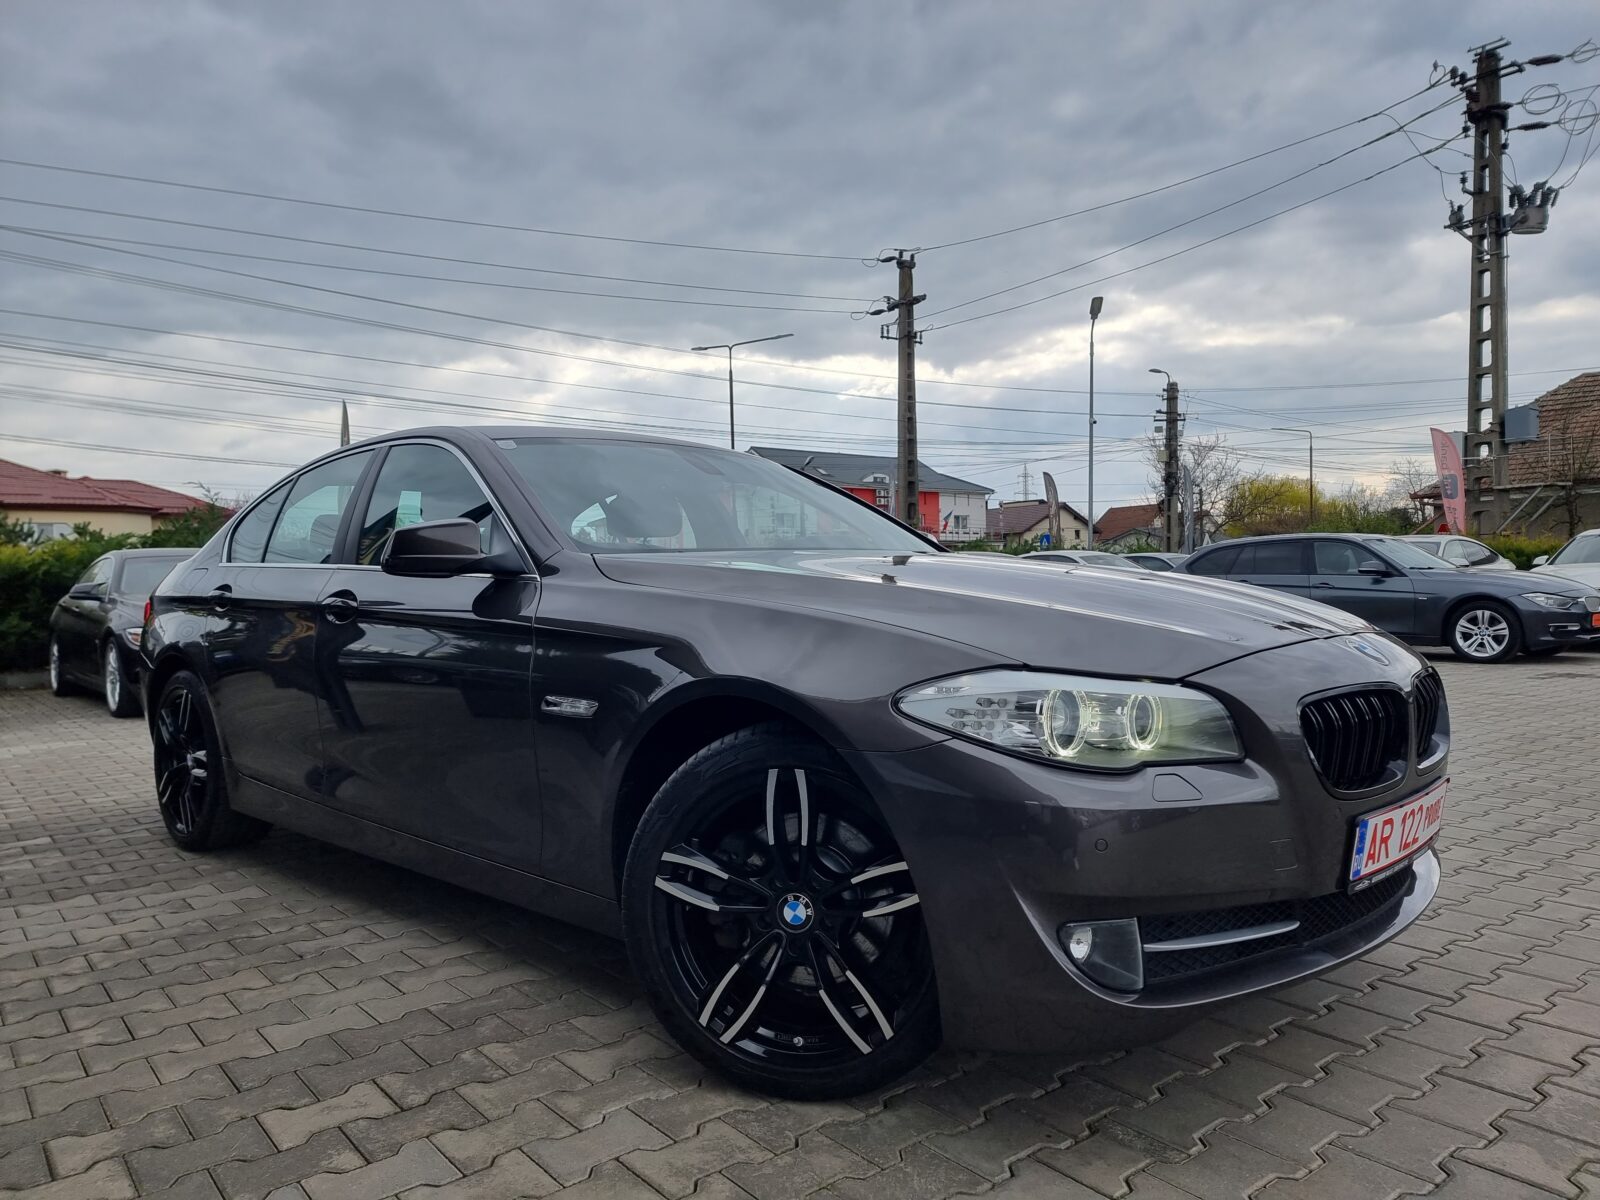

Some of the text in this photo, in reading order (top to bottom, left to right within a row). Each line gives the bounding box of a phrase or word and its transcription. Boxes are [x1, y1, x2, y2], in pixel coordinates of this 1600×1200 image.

[1364, 817, 1395, 869] AR
[1399, 804, 1425, 854] 122
[787, 894, 814, 916] BMW
